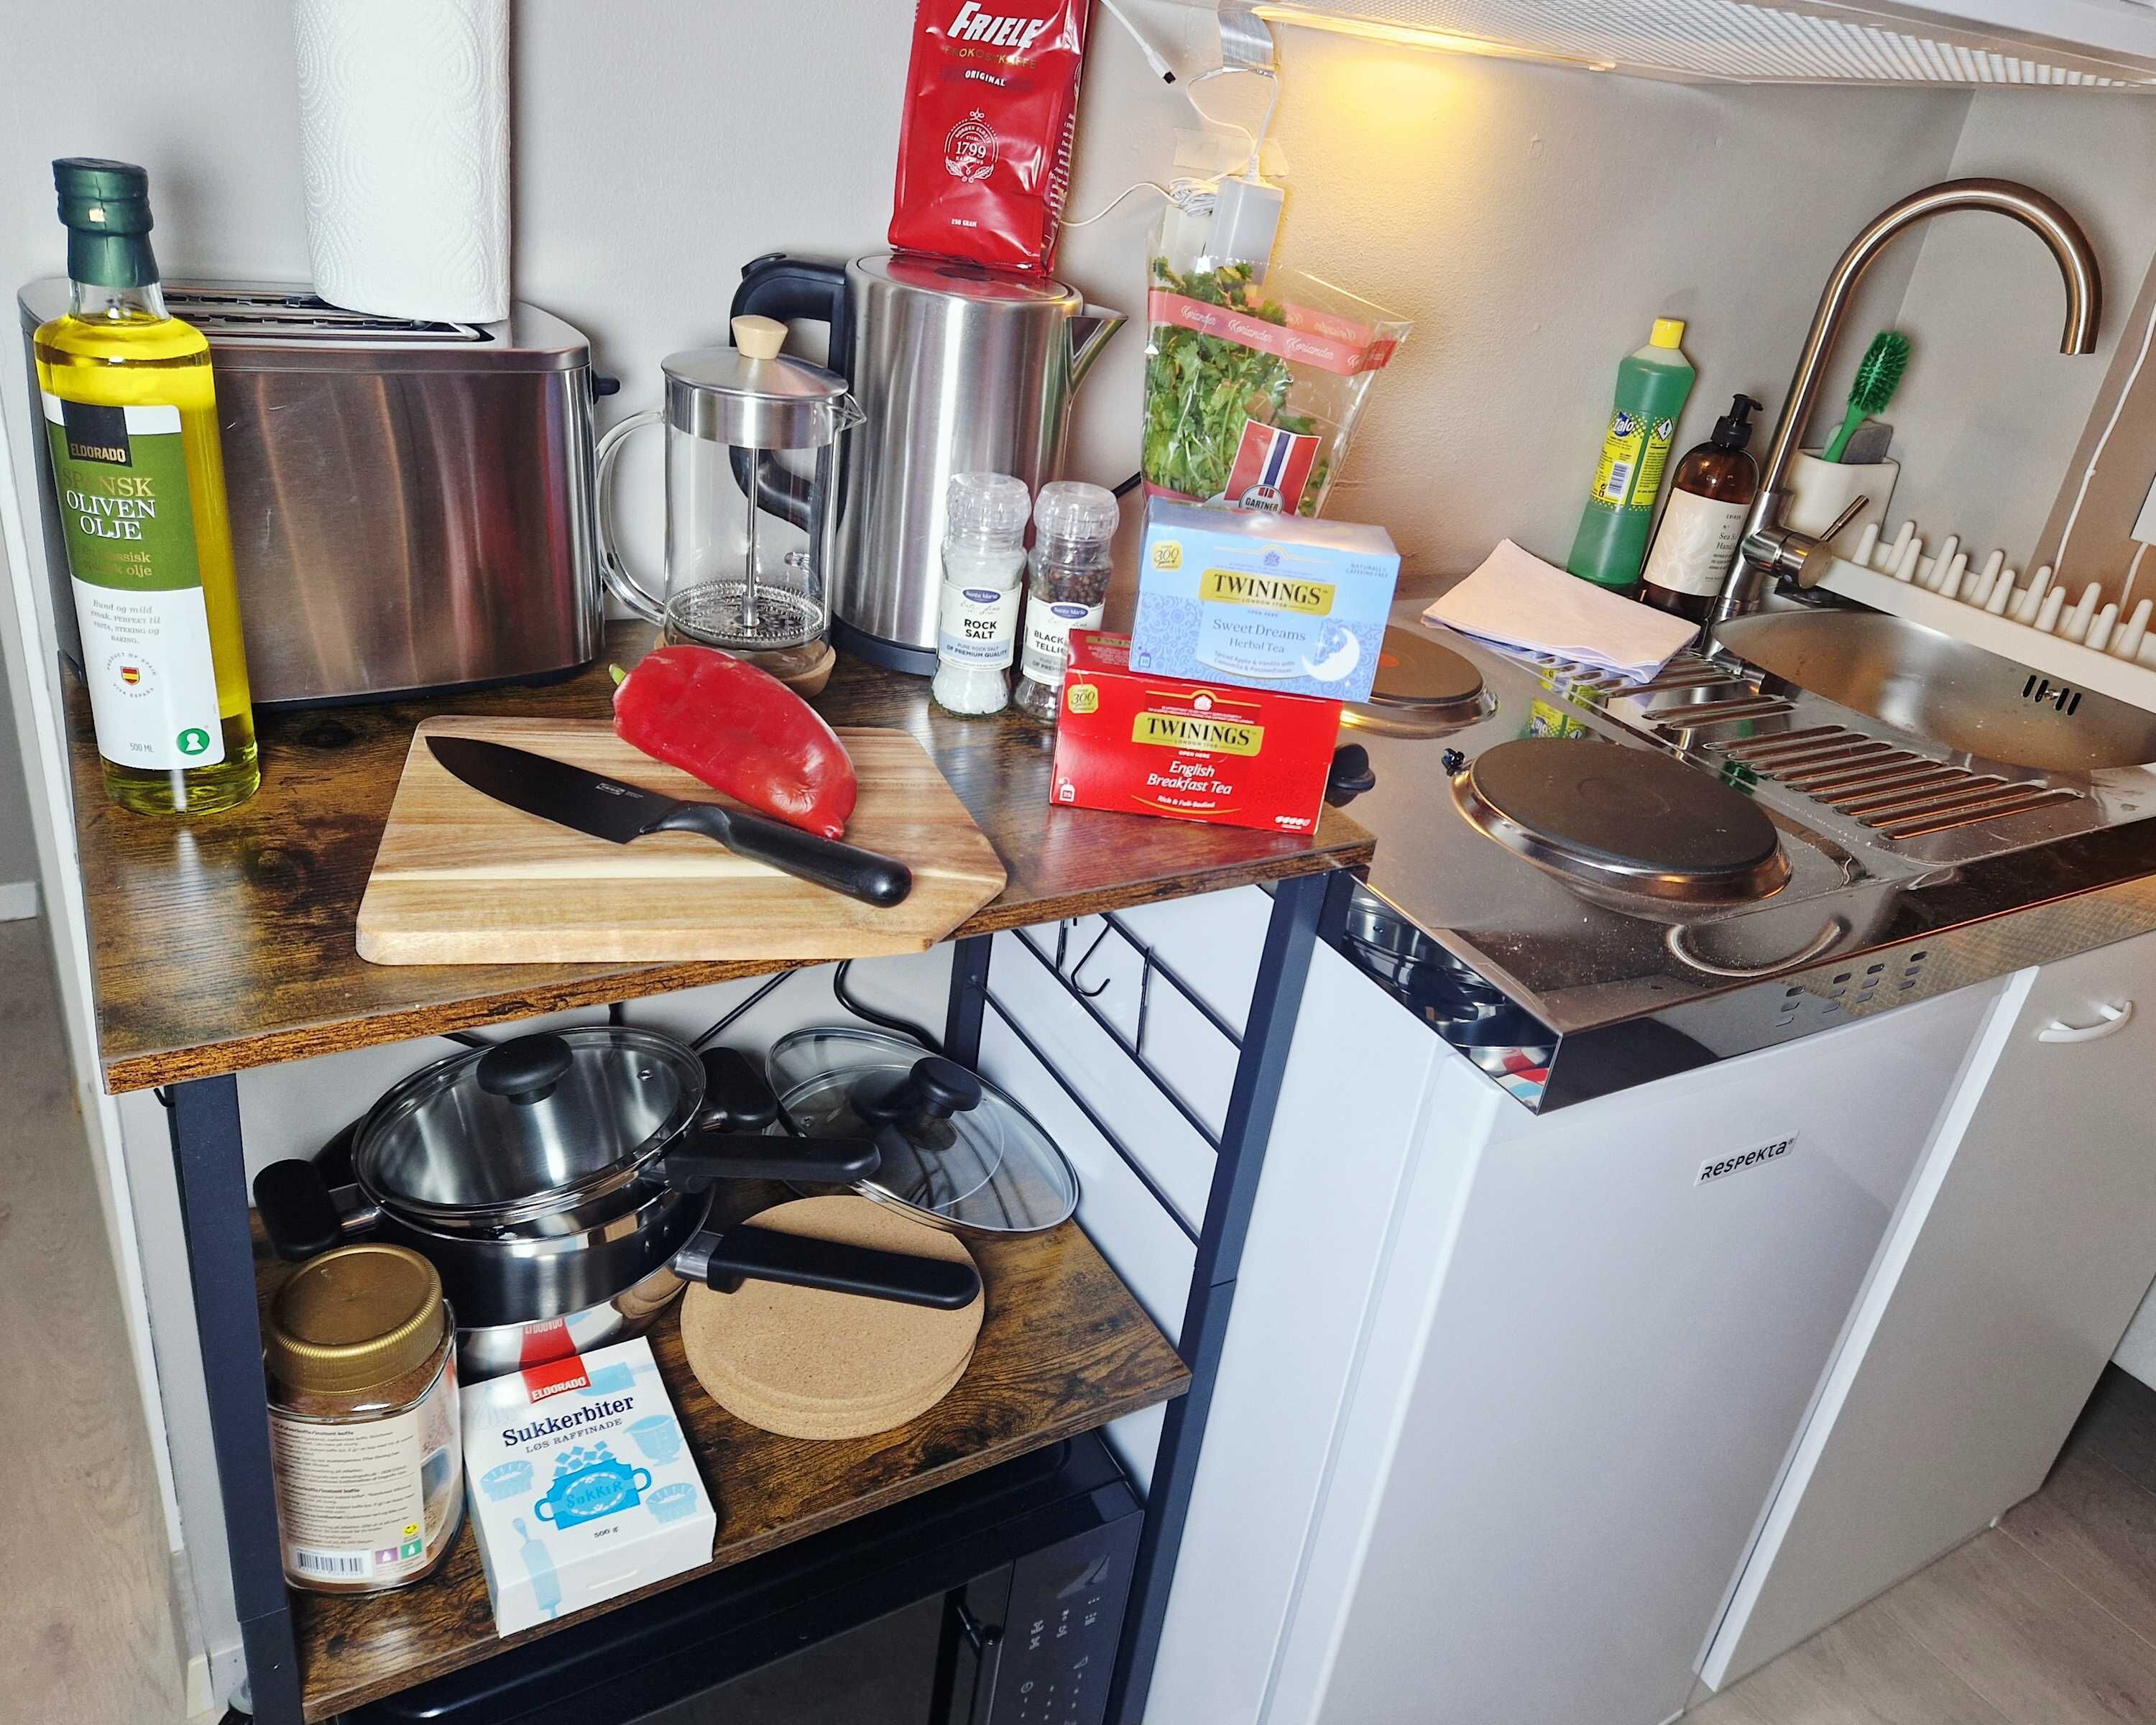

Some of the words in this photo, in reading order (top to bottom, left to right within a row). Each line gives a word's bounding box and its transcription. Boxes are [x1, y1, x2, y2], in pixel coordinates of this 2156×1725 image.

[946, 1, 1044, 49] FRIELE
[965, 70, 1005, 86] ORIGINAL
[955, 142, 987, 159] 1799
[1228, 319, 1273, 344] Koriander
[1286, 334, 1335, 359] Koriander
[1613, 418, 1634, 433] Zalo
[70, 443, 126, 463] ELDORADO
[63, 469, 155, 497] SPNSK
[66, 489, 156, 518] OLIVEN
[1245, 497, 1279, 512] GARTNER
[80, 515, 142, 540] OLJE
[1153, 548, 1179, 562] 300
[126, 564, 152, 577] olje
[1214, 574, 1321, 605] TWININGS
[964, 619, 998, 630] ROCK
[1213, 618, 1253, 634] Sweet
[1255, 624, 1306, 641] Dreams
[965, 629, 995, 639] SALT
[1035, 630, 1064, 645] BLACK
[954, 648, 984, 658] PREMIUM
[985, 650, 1008, 658] QUALITY
[1230, 638, 1264, 650] Herbal
[1266, 643, 1285, 653] Tea
[1071, 691, 1095, 704] 300
[1148, 717, 1250, 746] TWININGS
[129, 742, 143, 752] 500
[144, 744, 155, 753] ML
[1169, 760, 1215, 778] English
[1147, 773, 1209, 792] Breakfast
[1210, 780, 1234, 795] Tea
[532, 1376, 587, 1401] ELDORADO
[502, 1397, 634, 1447] Sukkerbiter
[525, 1440, 550, 1455] LØS
[553, 1418, 623, 1445] RAFFINADE
[594, 1529, 610, 1538] 500
